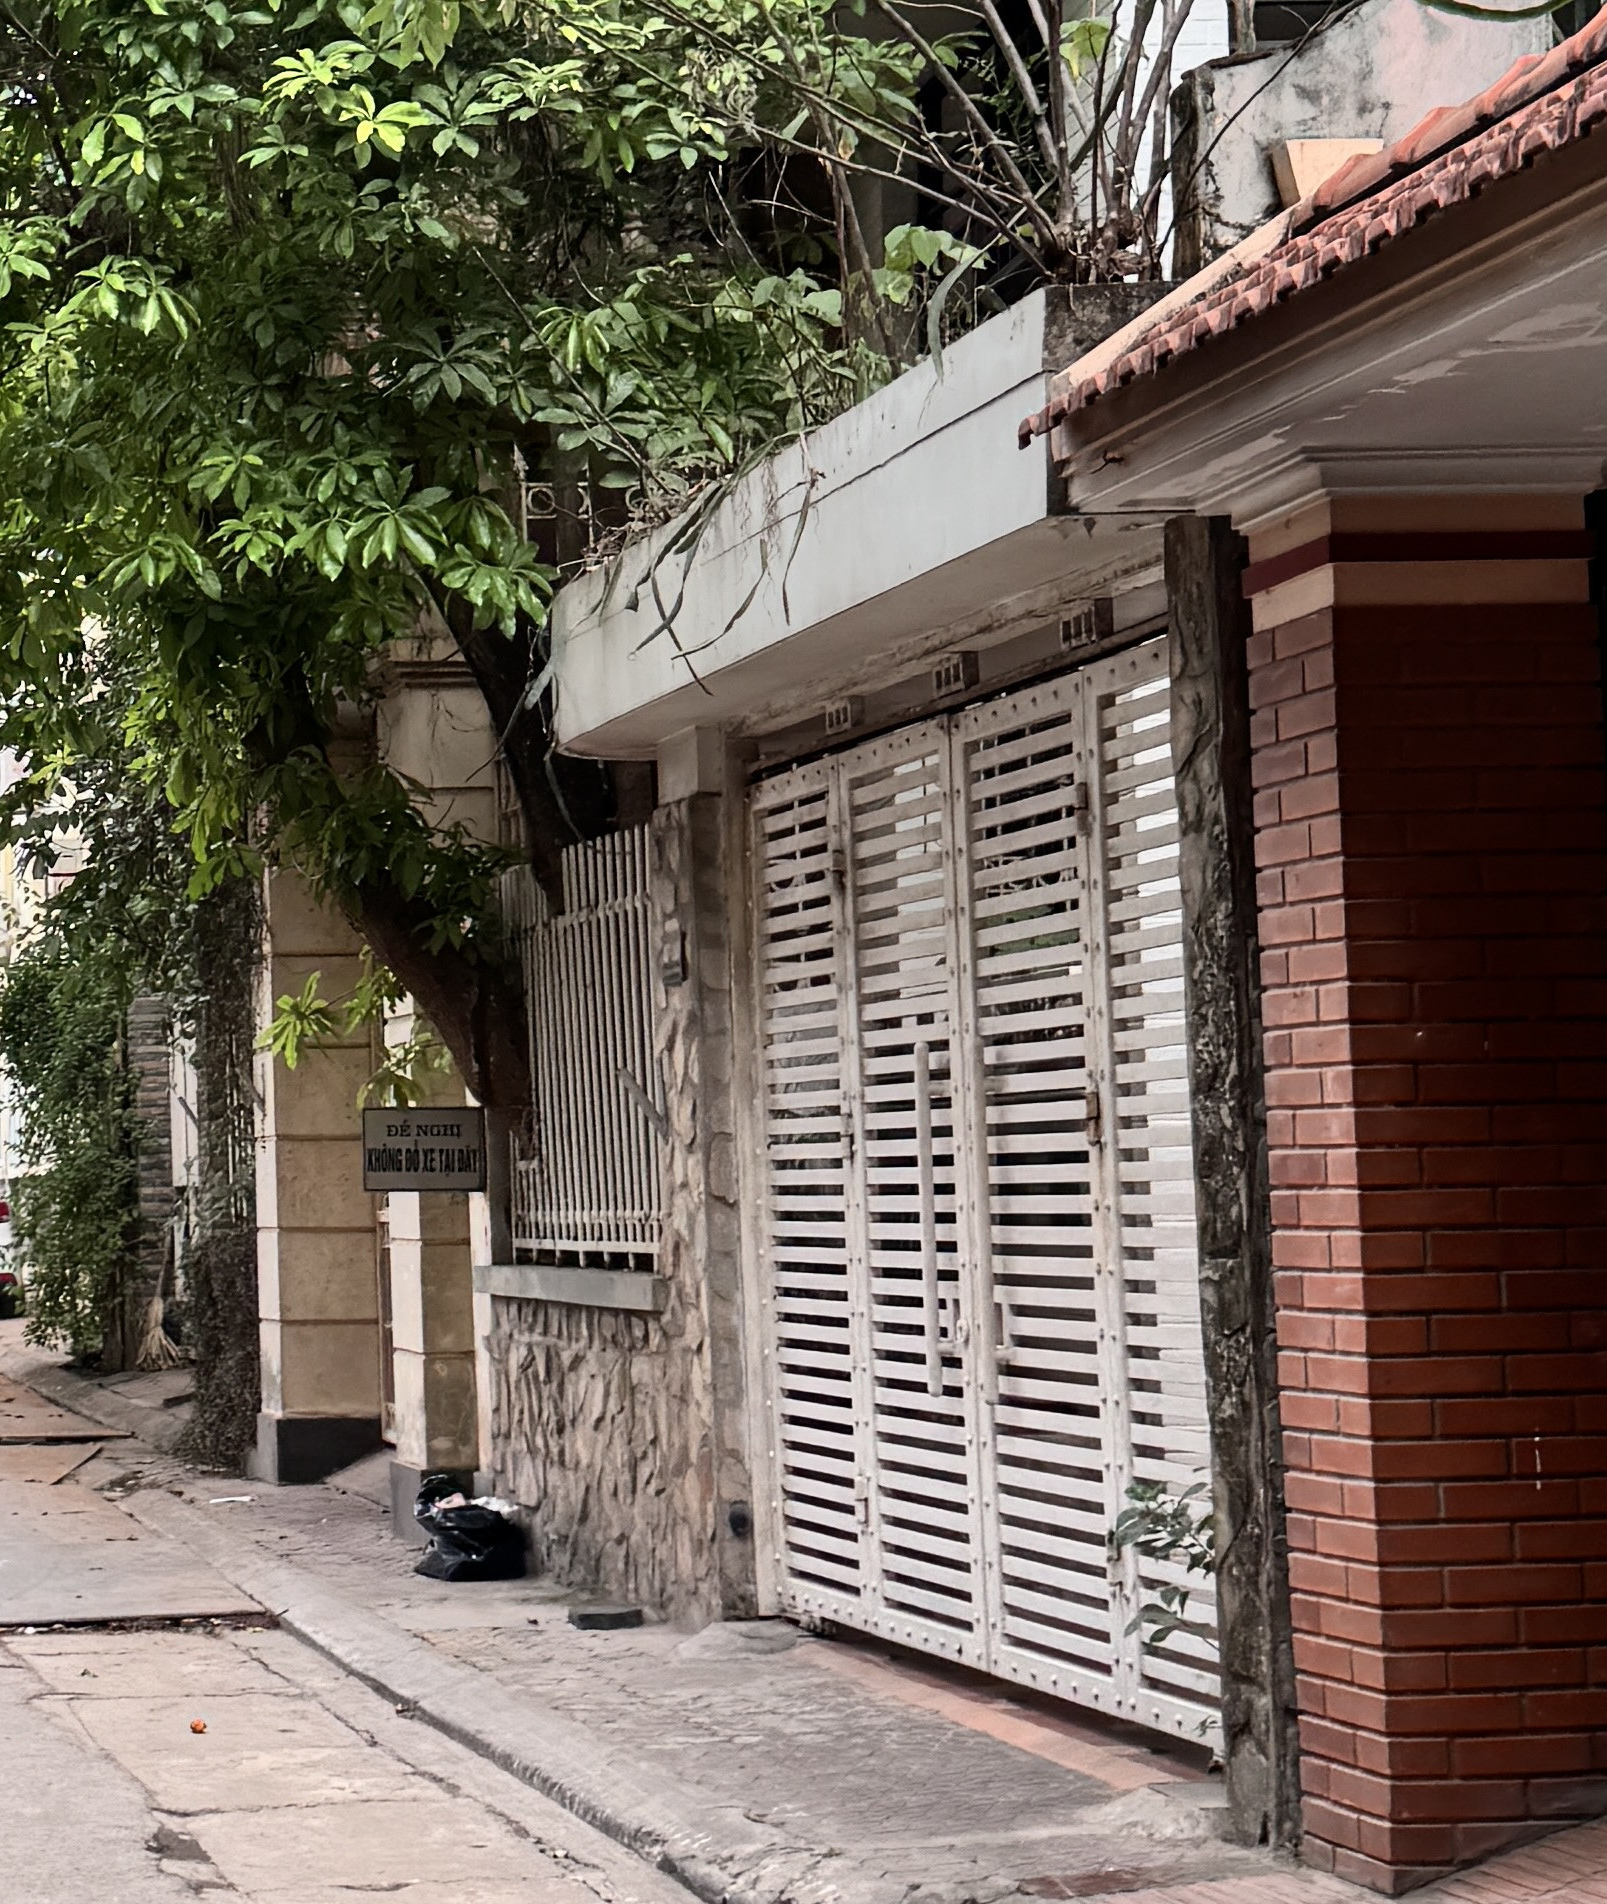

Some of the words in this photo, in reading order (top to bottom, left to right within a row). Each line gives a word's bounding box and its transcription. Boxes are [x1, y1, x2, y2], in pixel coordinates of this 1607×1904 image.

[415, 1124, 462, 1139] NGHỊ
[367, 1143, 403, 1173] KHÔNG
[421, 1148, 437, 1173] XE
[438, 1148, 455, 1178] TẠI
